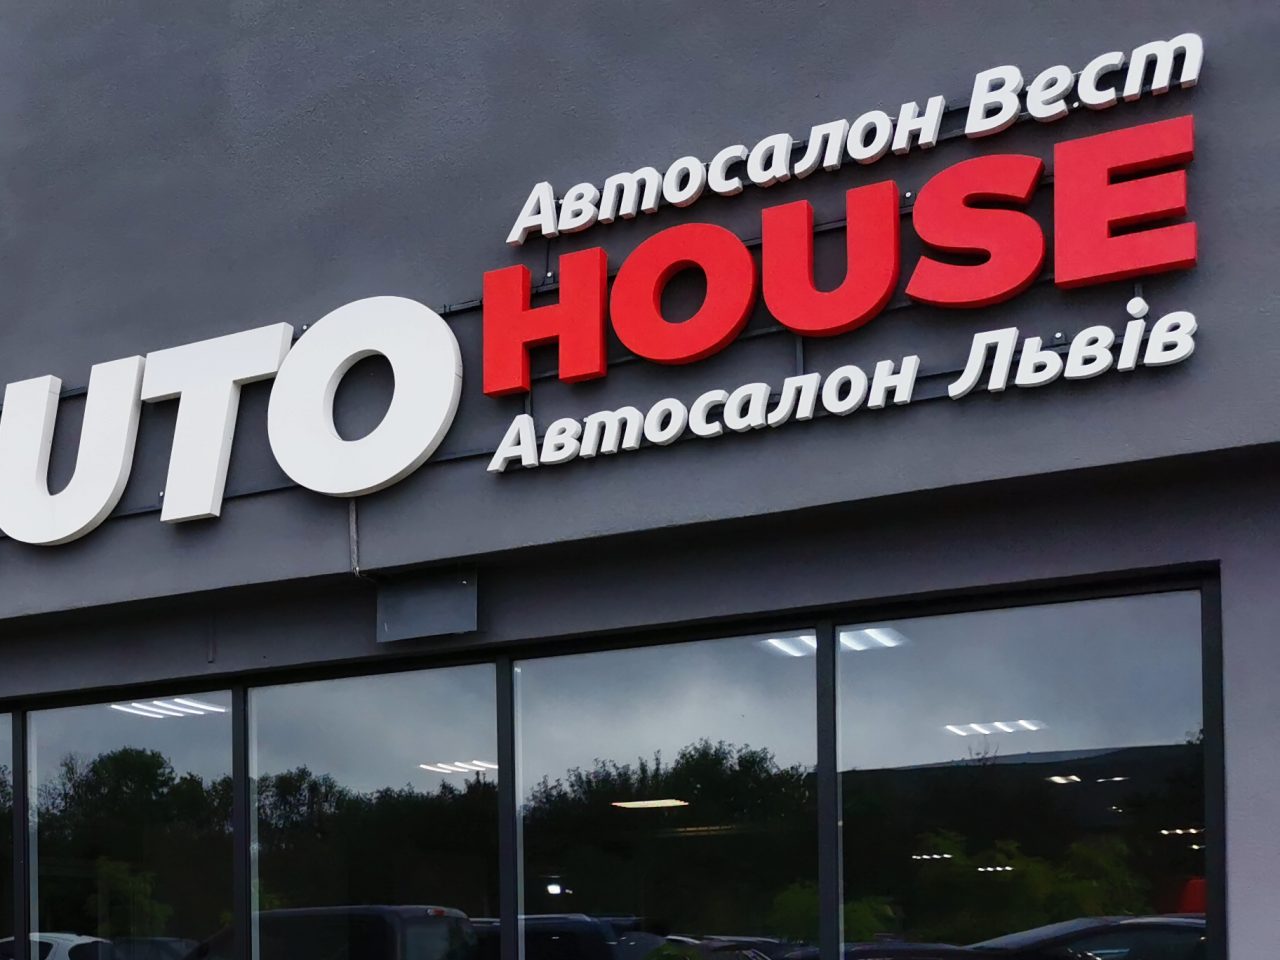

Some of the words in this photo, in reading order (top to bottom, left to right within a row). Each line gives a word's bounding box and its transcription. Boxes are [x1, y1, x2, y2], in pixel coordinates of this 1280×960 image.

[506, 94, 946, 246] Автосалон
[963, 31, 1204, 138] Вест
[482, 115, 1199, 397] HOUSE
[486, 355, 920, 474] Автосалон
[948, 297, 1199, 399] Львів
